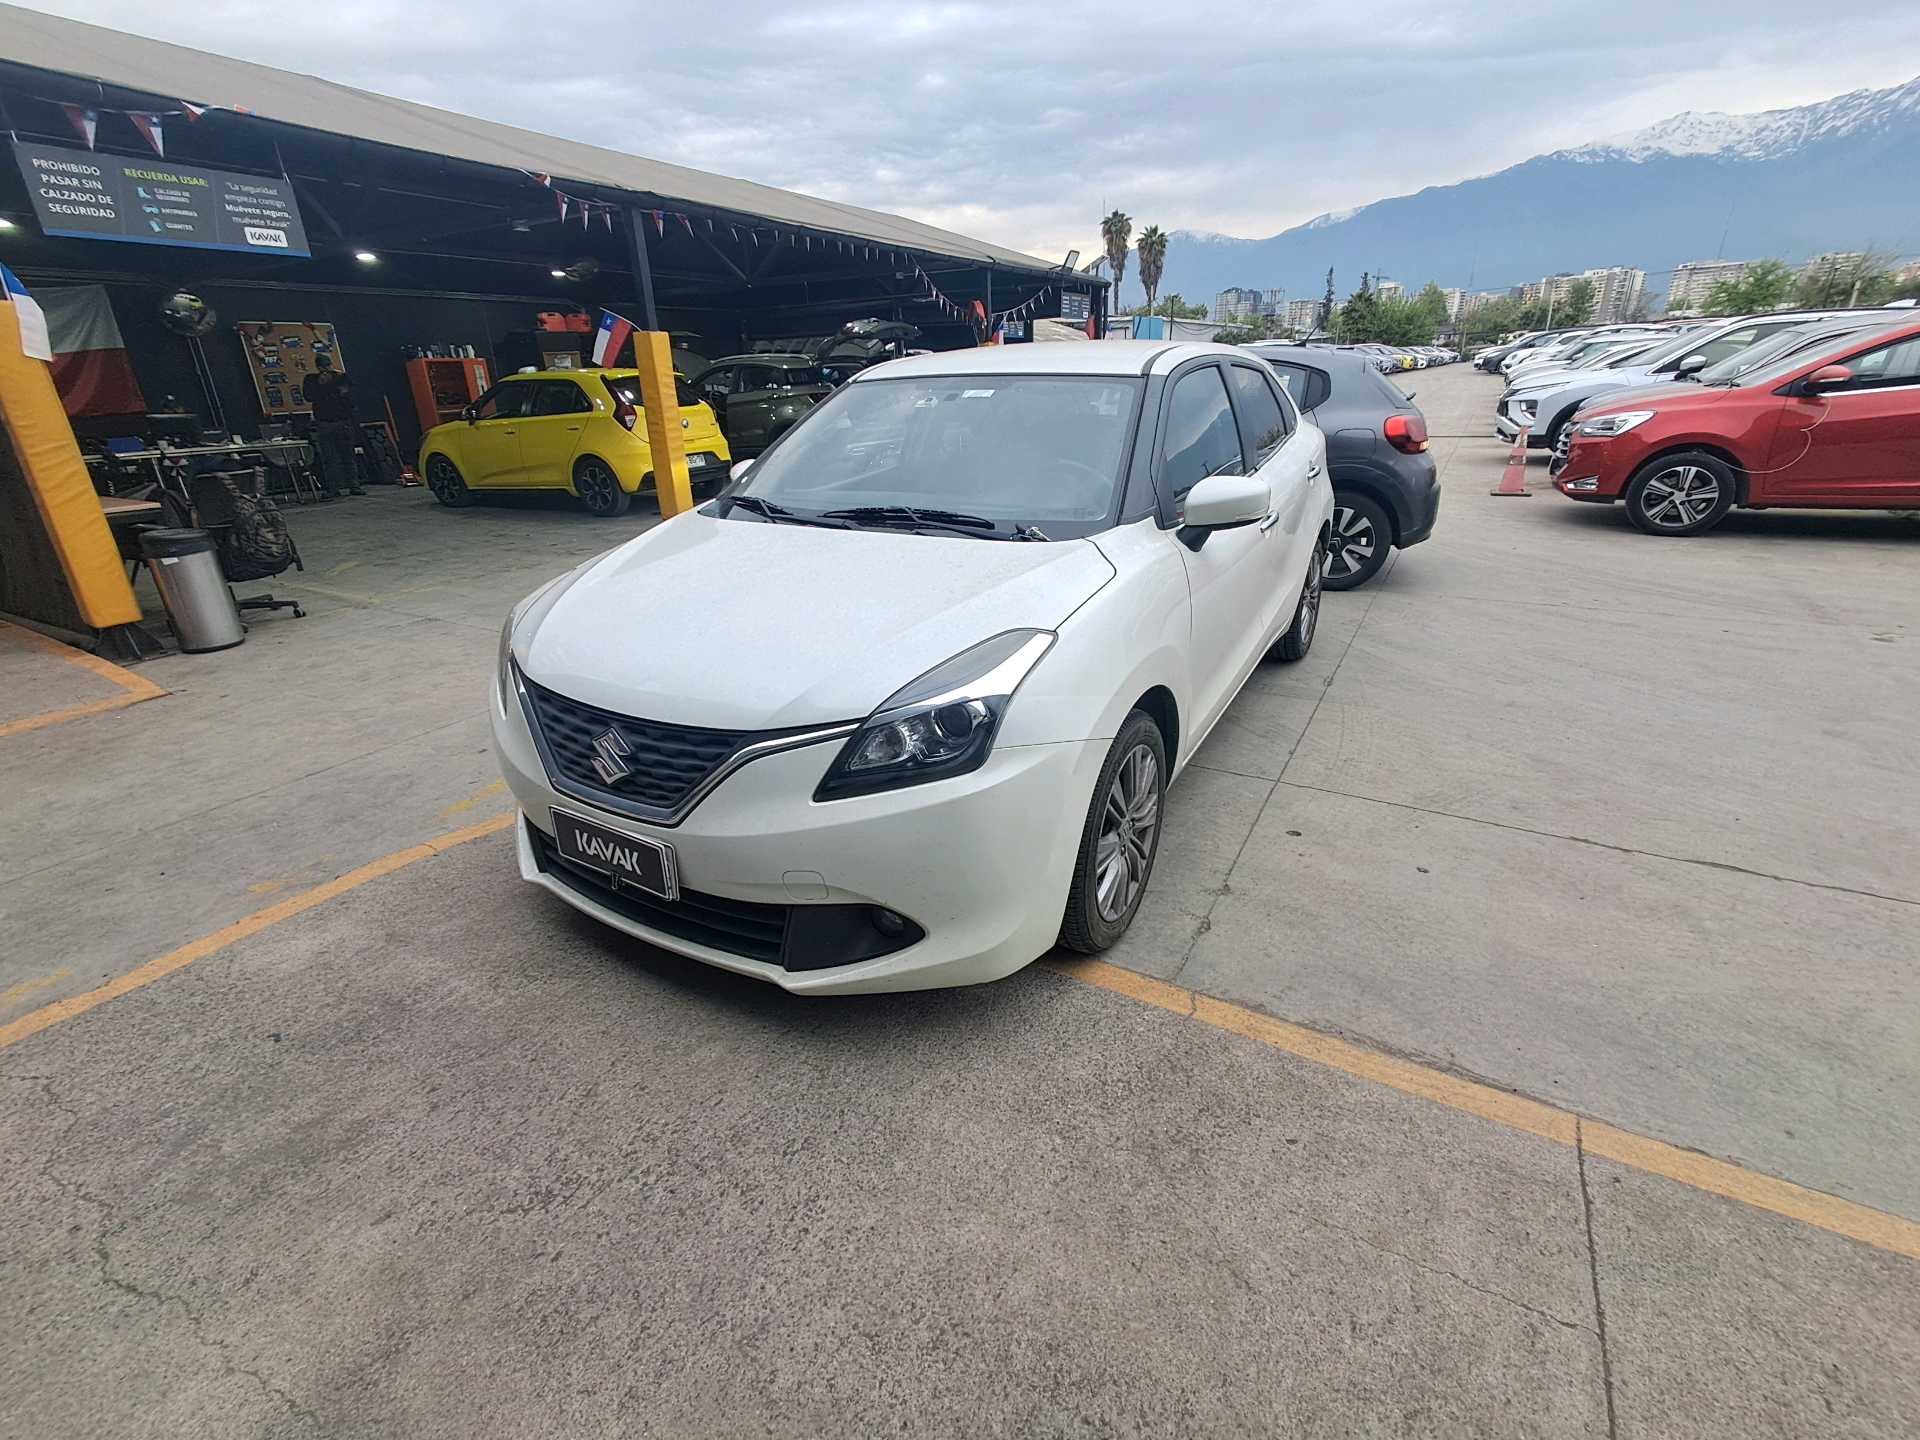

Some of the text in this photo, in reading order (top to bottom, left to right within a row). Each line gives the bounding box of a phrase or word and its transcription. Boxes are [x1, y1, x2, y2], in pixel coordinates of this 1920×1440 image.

[32, 158, 100, 176] PROHIBIDO
[123, 167, 179, 184] RECUERDA
[40, 173, 103, 190] PASAR SIN
[40, 188, 115, 205] CALZADO DE
[48, 203, 116, 219] SEGURIDAD
[250, 231, 282, 243] KAVAK
[574, 828, 642, 876] KAVAK
